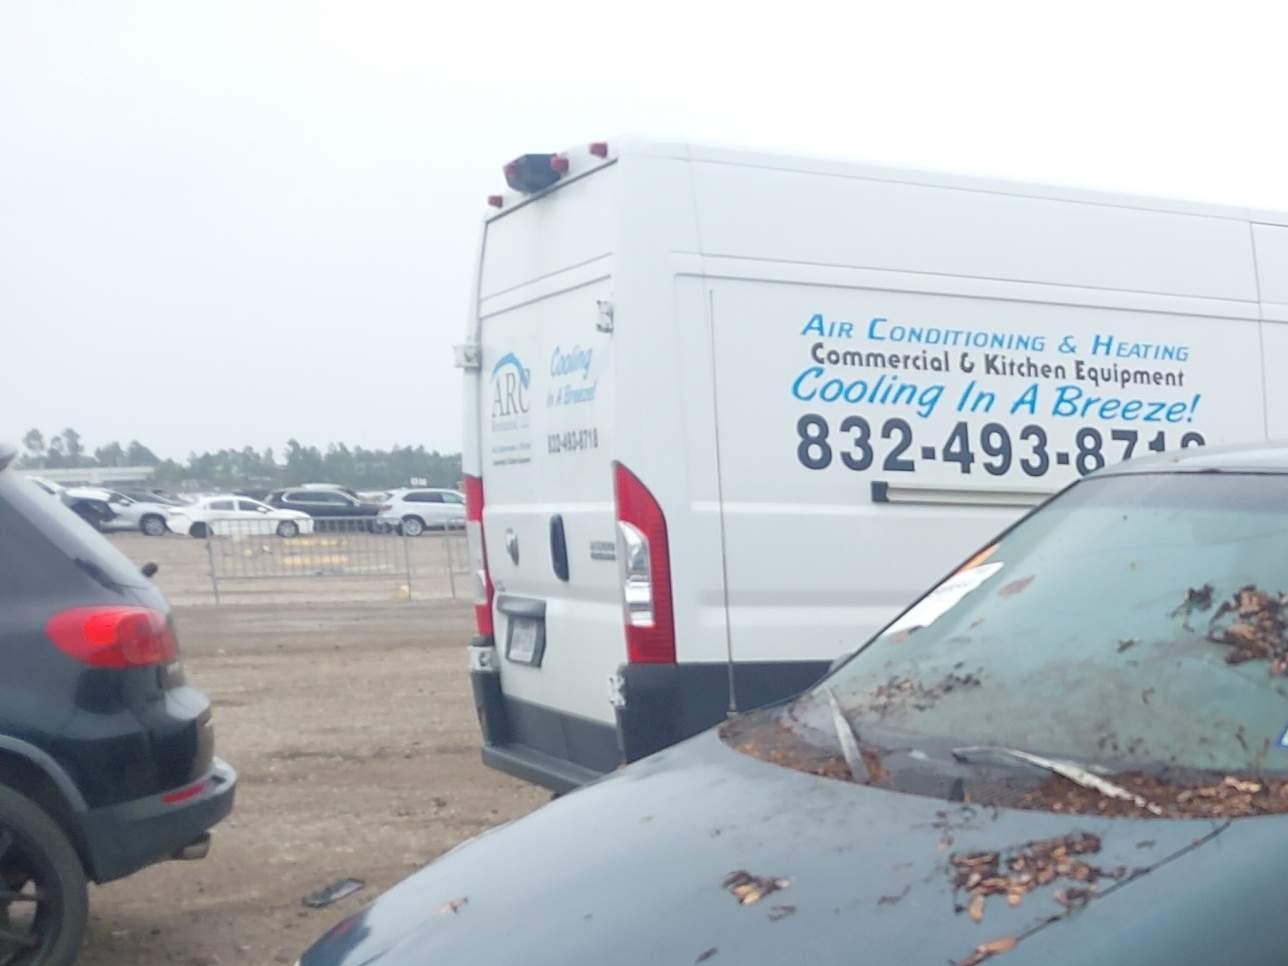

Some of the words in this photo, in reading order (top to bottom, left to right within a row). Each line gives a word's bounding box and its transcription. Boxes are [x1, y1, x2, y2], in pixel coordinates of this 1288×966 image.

[811, 341, 950, 373] Commercial
[984, 353, 1067, 380] Kitchen
[1075, 360, 1185, 389] Equipment
[1057, 335, 1078, 354] &
[491, 366, 531, 418] ARC
[791, 366, 945, 418] Cooling
[956, 380, 996, 412] In
[1009, 383, 1040, 416] A
[1052, 384, 1201, 423] Breeze!
[796, 413, 1206, 478] 832-493-871
